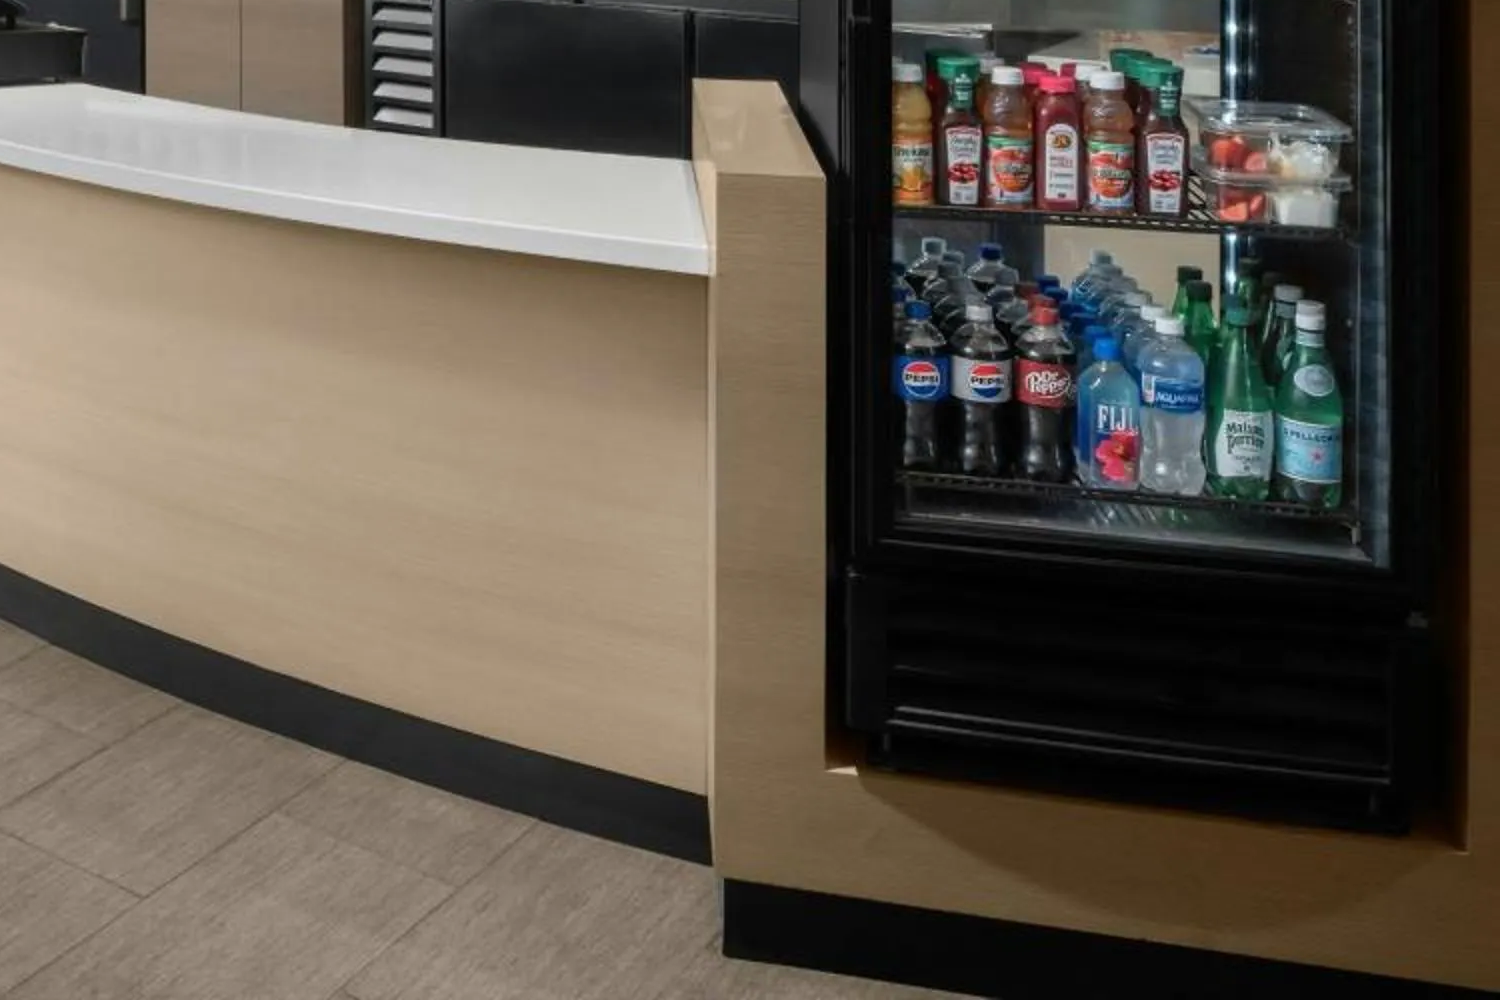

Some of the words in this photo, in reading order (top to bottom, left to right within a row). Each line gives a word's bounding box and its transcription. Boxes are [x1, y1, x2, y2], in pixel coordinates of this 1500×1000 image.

[904, 372, 939, 383] PEPSI
[1043, 370, 1058, 381] Dr
[1097, 403, 1136, 431] FIJI
